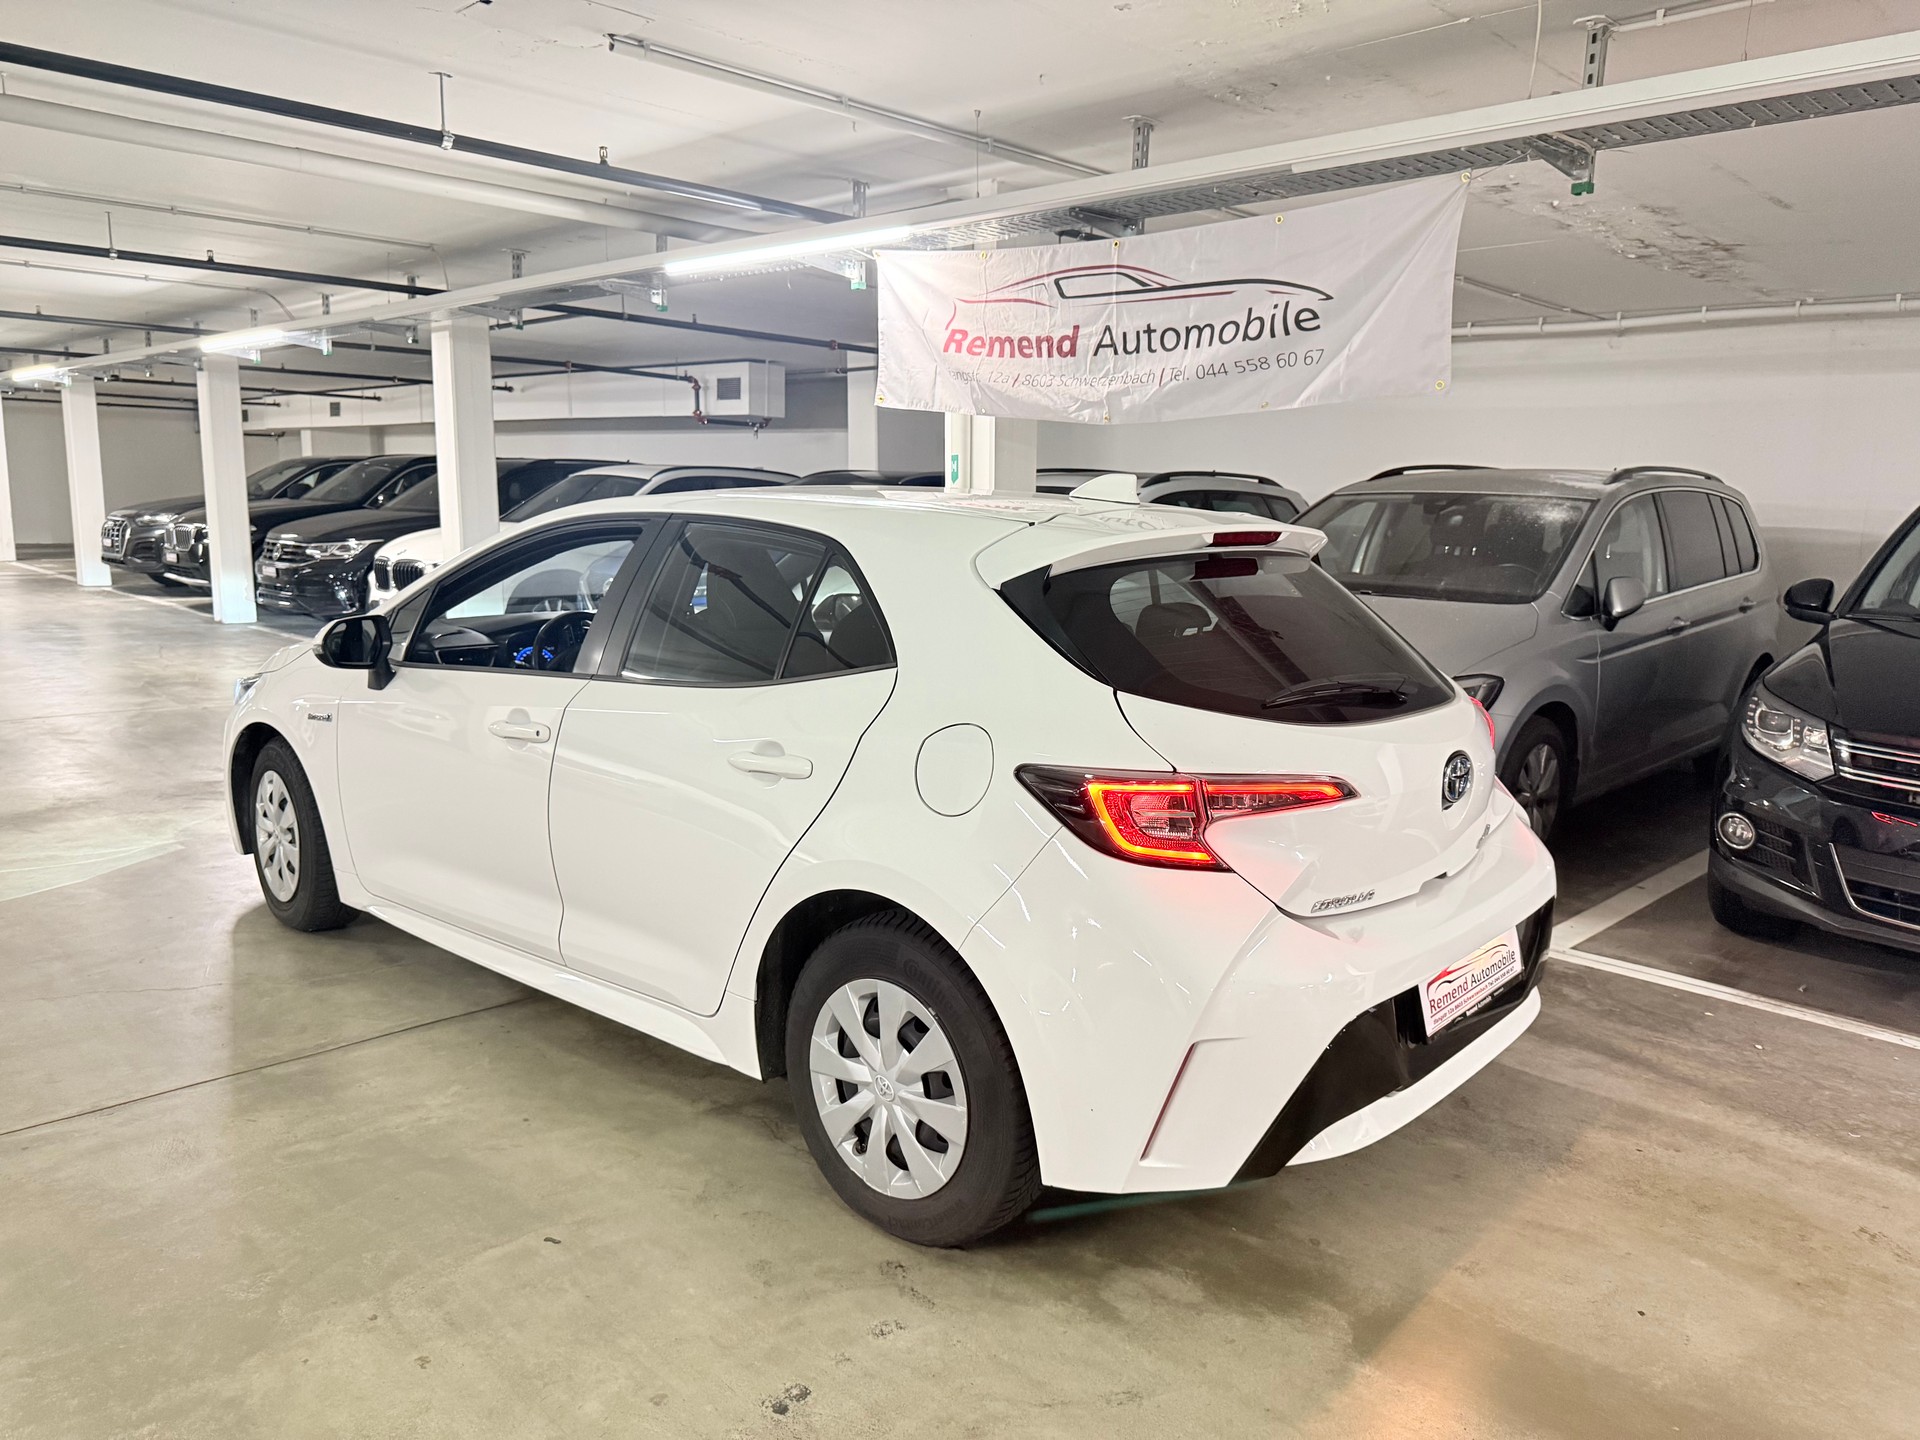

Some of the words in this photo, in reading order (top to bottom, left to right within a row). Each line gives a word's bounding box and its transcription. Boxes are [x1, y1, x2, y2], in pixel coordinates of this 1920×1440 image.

[943, 324, 1080, 358] Remend
[1093, 300, 1321, 357] Automobile
[1021, 374, 1055, 388] 8603
[1056, 369, 1156, 389] Schwerzenbach
[1169, 365, 1190, 382] Tel.
[1196, 362, 1229, 380] 044
[1234, 356, 1271, 374] 558
[1276, 351, 1297, 369] 60
[1303, 349, 1325, 366] 67
[1429, 977, 1469, 1014] Remend
[1470, 950, 1515, 986] Automobile
